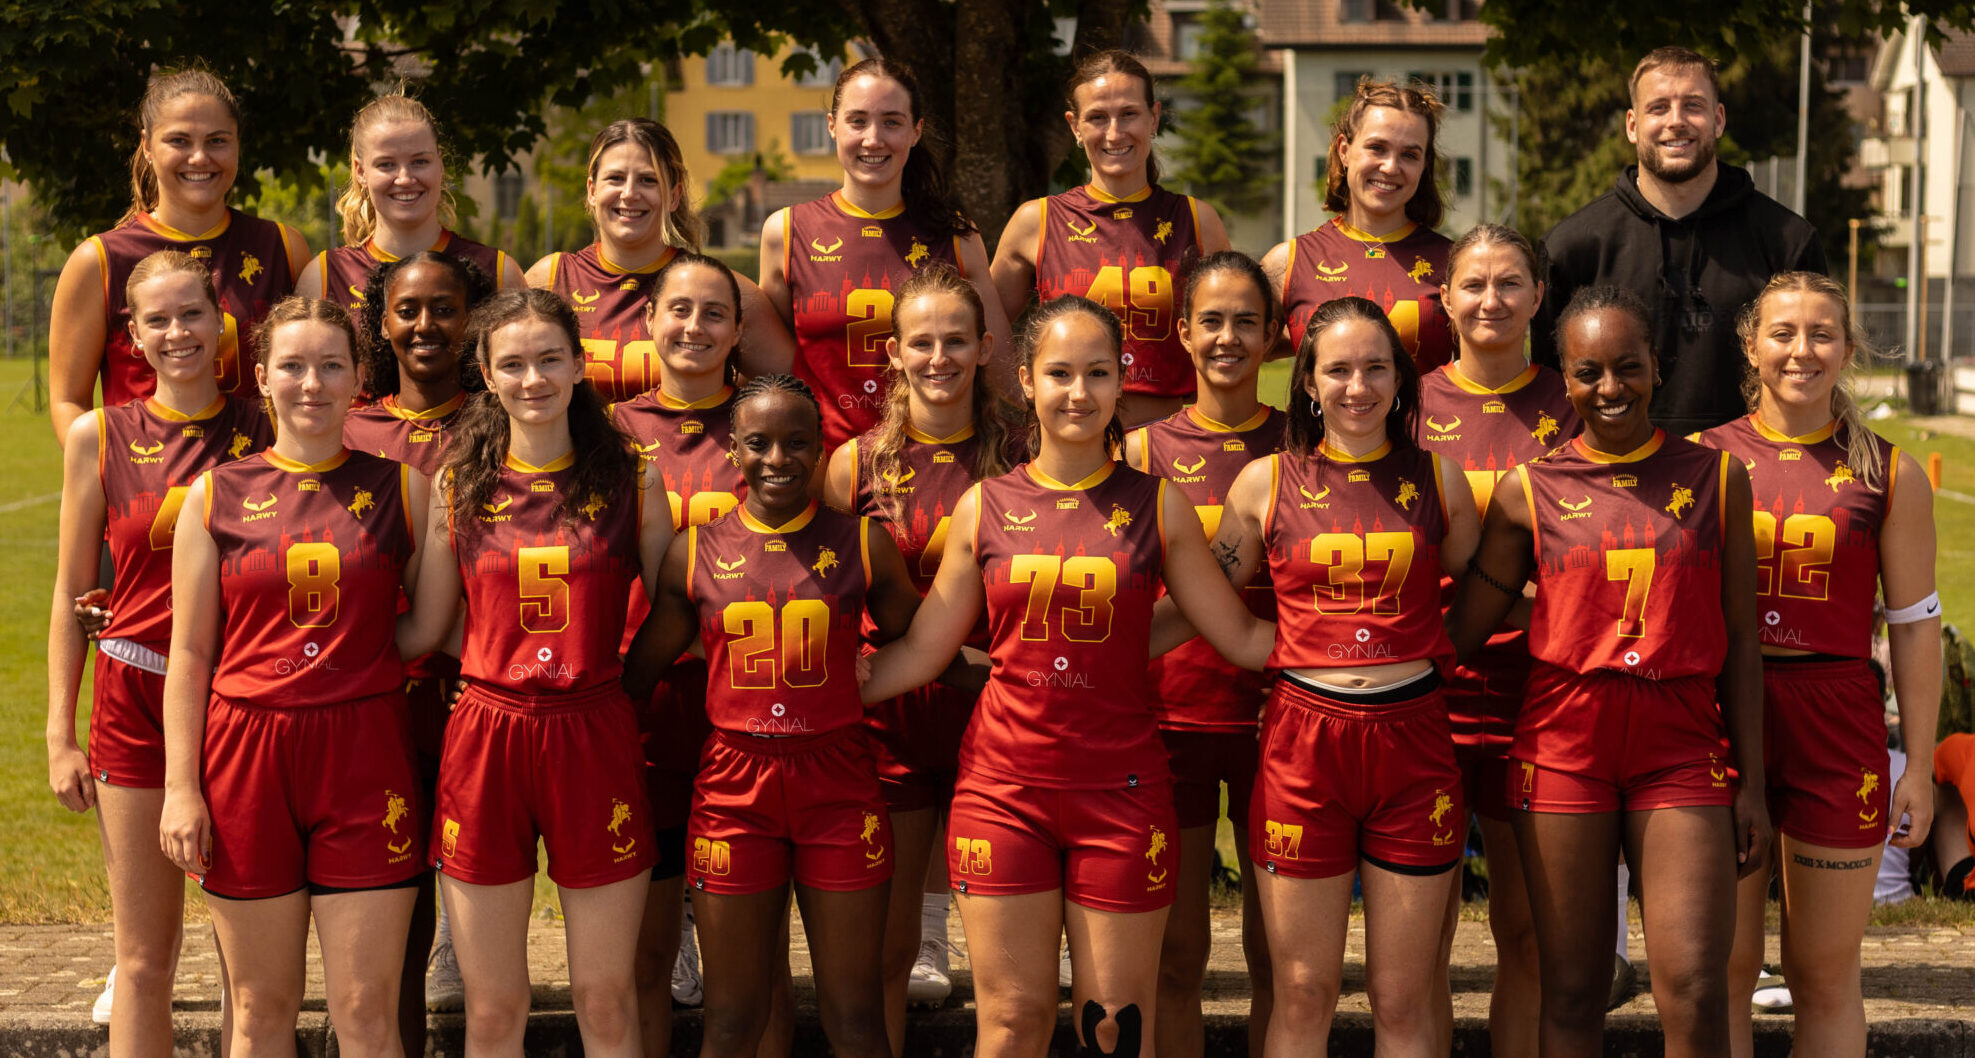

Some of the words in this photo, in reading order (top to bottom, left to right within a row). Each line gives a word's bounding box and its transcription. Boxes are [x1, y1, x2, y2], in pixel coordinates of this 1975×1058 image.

[1113, 211, 1133, 220] FAMILY
[861, 228, 882, 238] FAMILY
[1068, 235, 1097, 244] HARWY
[810, 254, 842, 262] HARWY
[1085, 265, 1174, 342] 49
[846, 288, 897, 367] 2
[1483, 403, 1504, 413] FAMILY
[680, 424, 703, 434] FAMILY
[408, 431, 433, 443] FAMILY
[1426, 434, 1461, 442] HARWY
[1222, 442, 1244, 452] FAMILY
[130, 456, 163, 464] HARWY
[932, 454, 954, 464] FAMILY
[1778, 450, 1801, 461] FAMILY
[1173, 476, 1206, 484] HARWY
[1346, 472, 1369, 483] FAMILY
[1611, 477, 1636, 488] FAMILY
[297, 482, 319, 492] FAMILY
[531, 483, 554, 493] FAMILY
[1056, 500, 1079, 510] FAMILY
[1299, 502, 1329, 510] HARWY
[242, 511, 278, 523] HARWY
[477, 514, 512, 522] HARWY
[1559, 512, 1592, 521] HARWY
[1001, 525, 1034, 533] HARWY
[763, 542, 786, 552] FAMILY
[712, 572, 743, 580] HARWY
[1309, 531, 1415, 616] 37
[286, 542, 340, 629] 8
[518, 546, 570, 634] 5
[1010, 554, 1117, 643] 73
[1606, 547, 1656, 639] 7
[722, 599, 830, 690] 20
[1327, 643, 1399, 660] GYNIAL
[508, 663, 581, 681] GYNIAL
[1026, 670, 1095, 690] GYNIAL
[745, 717, 815, 734] GYNIAL
[1521, 761, 1535, 793] 7
[441, 818, 460, 858] 5
[1264, 819, 1304, 861] 37
[693, 837, 730, 876] 20
[956, 836, 992, 876] 73
